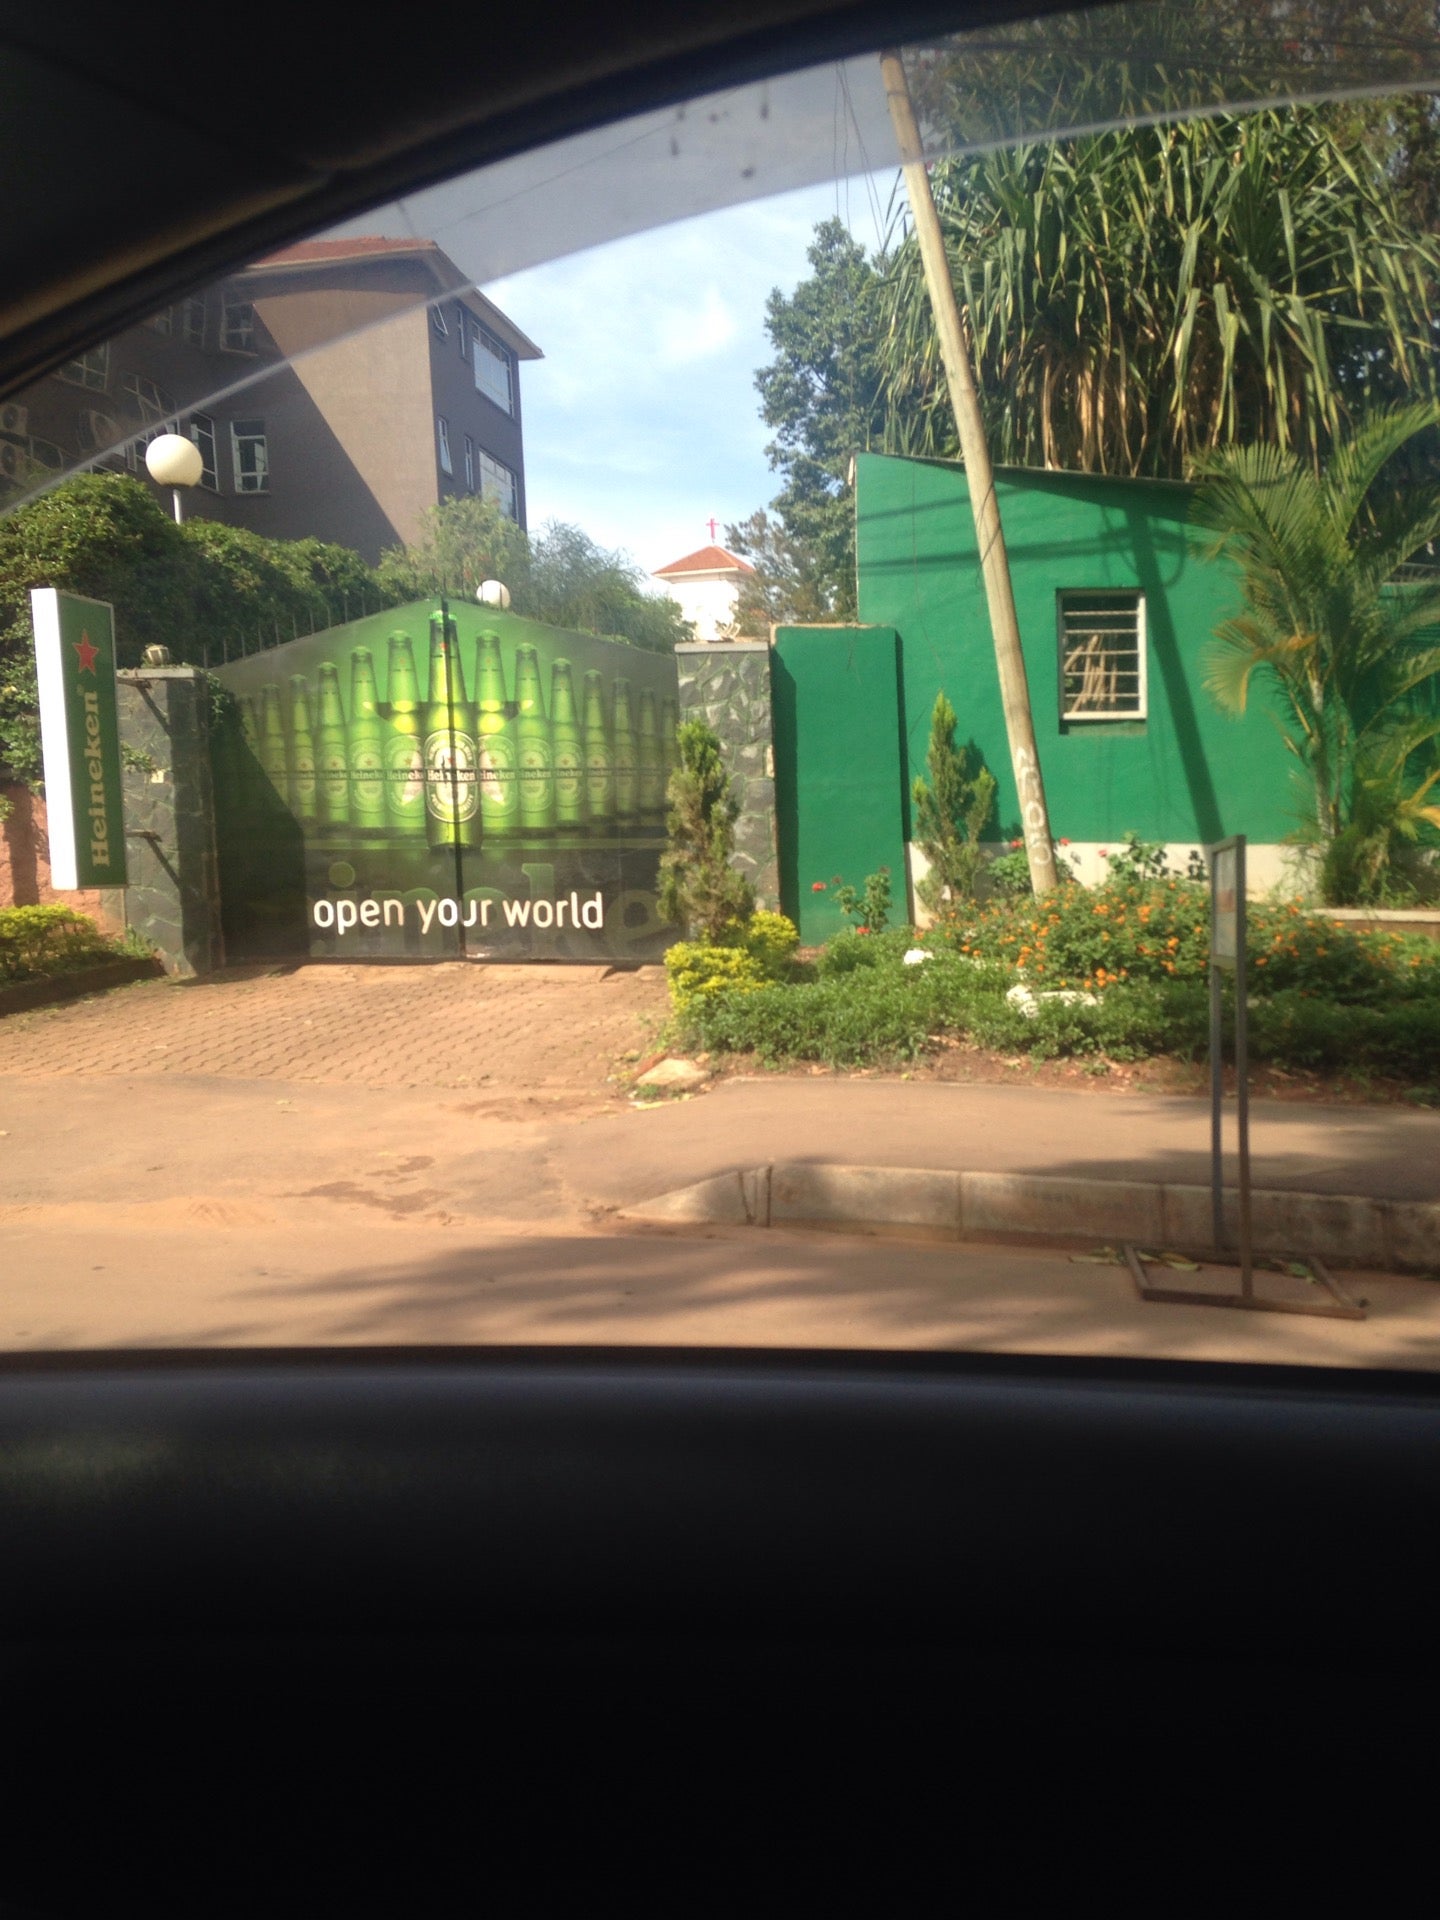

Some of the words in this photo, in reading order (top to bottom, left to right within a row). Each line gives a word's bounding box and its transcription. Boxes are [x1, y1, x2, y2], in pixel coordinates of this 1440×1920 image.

[83, 690, 111, 868] Heineken
[427, 769, 476, 781] Heinken
[312, 898, 404, 935] open
[416, 898, 492, 935] your
[502, 891, 603, 929] world
